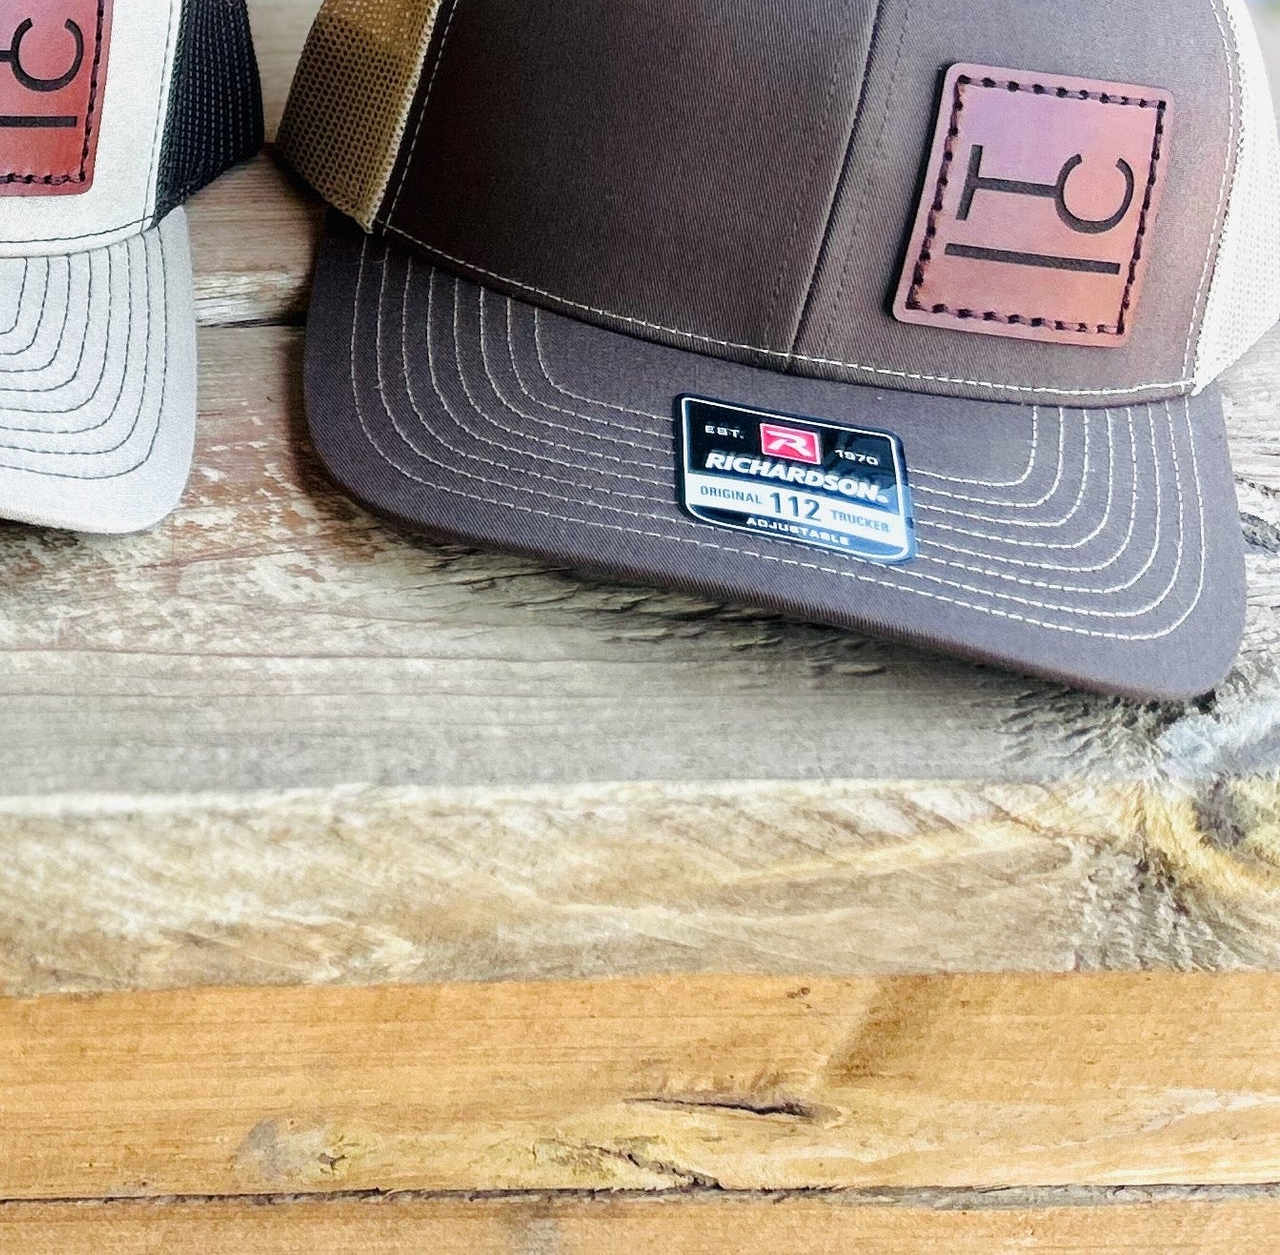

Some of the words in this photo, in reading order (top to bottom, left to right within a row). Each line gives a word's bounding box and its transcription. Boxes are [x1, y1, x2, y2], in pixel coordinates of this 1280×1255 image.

[704, 425, 744, 440] EST.
[835, 449, 879, 466] 1970
[700, 486, 762, 504] ORIGINAL
[770, 492, 822, 522] 112
[830, 509, 889, 533] TRUCKER
[746, 517, 849, 545] ADJUSTABLE
